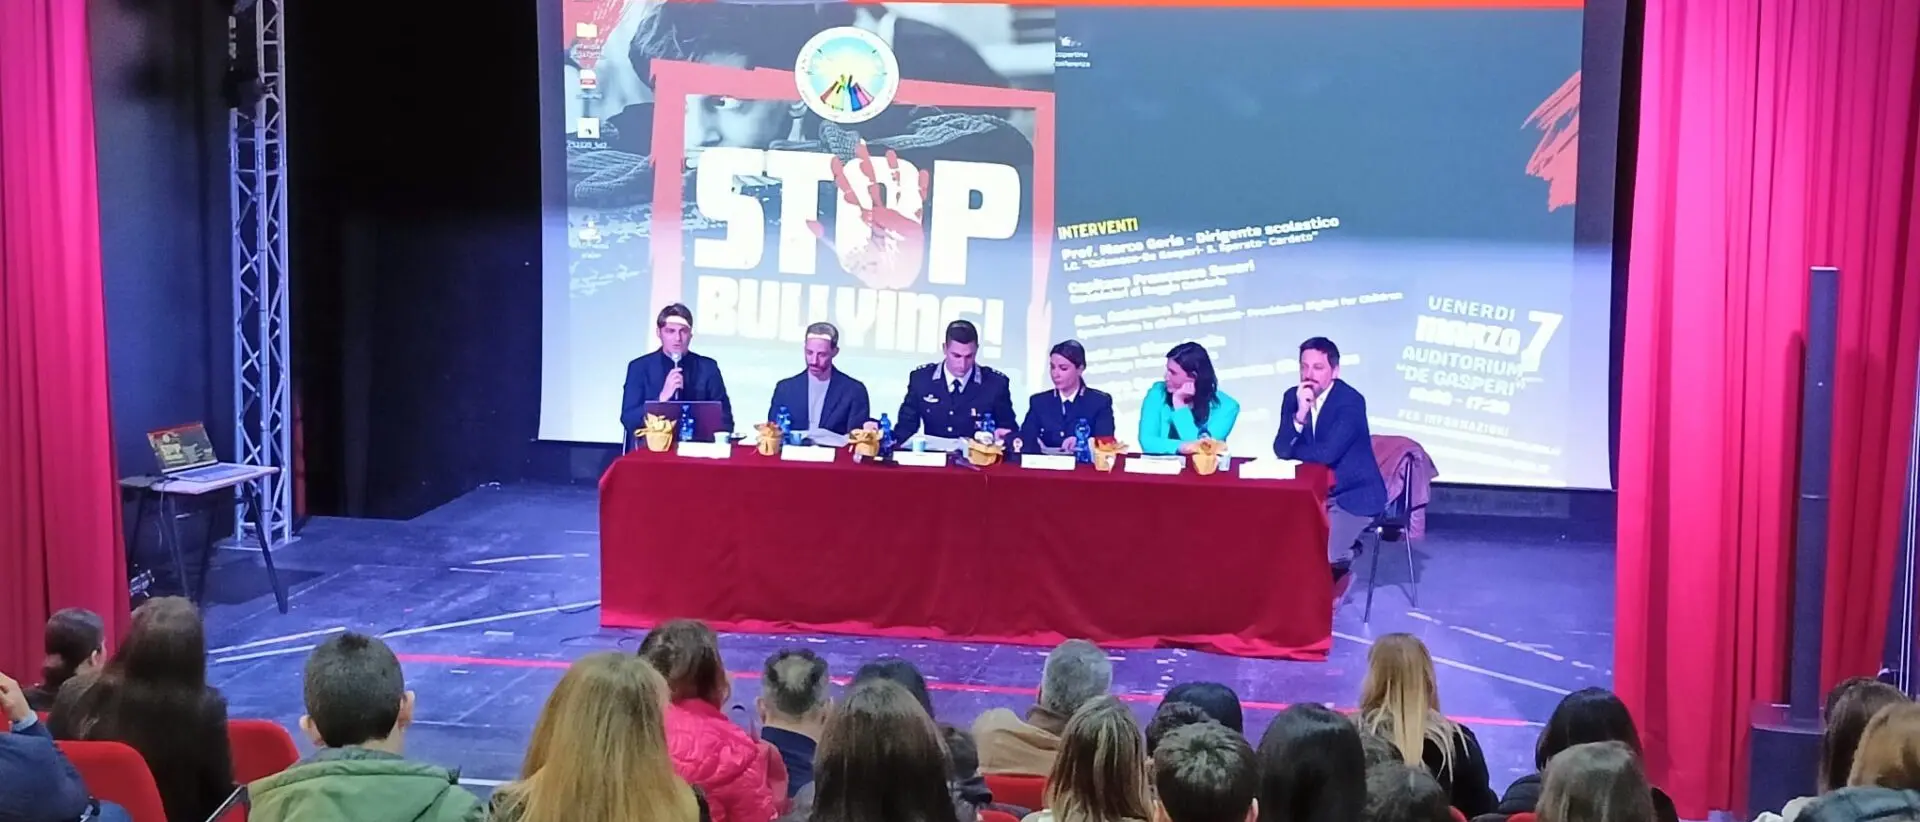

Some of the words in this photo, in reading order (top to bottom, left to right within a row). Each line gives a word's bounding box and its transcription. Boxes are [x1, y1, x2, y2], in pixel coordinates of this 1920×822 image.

[694, 146, 1021, 285] STOP
[1057, 217, 1139, 240] INTERVENTI
[1265, 216, 1339, 235] scolastico
[696, 275, 1004, 358] BULLYING!
[1415, 315, 1521, 355] MARZO
[1521, 310, 1563, 372] 7
[1402, 346, 1524, 378] AUDITORIUM
[1424, 413, 1510, 437] INFORMAZIONI
